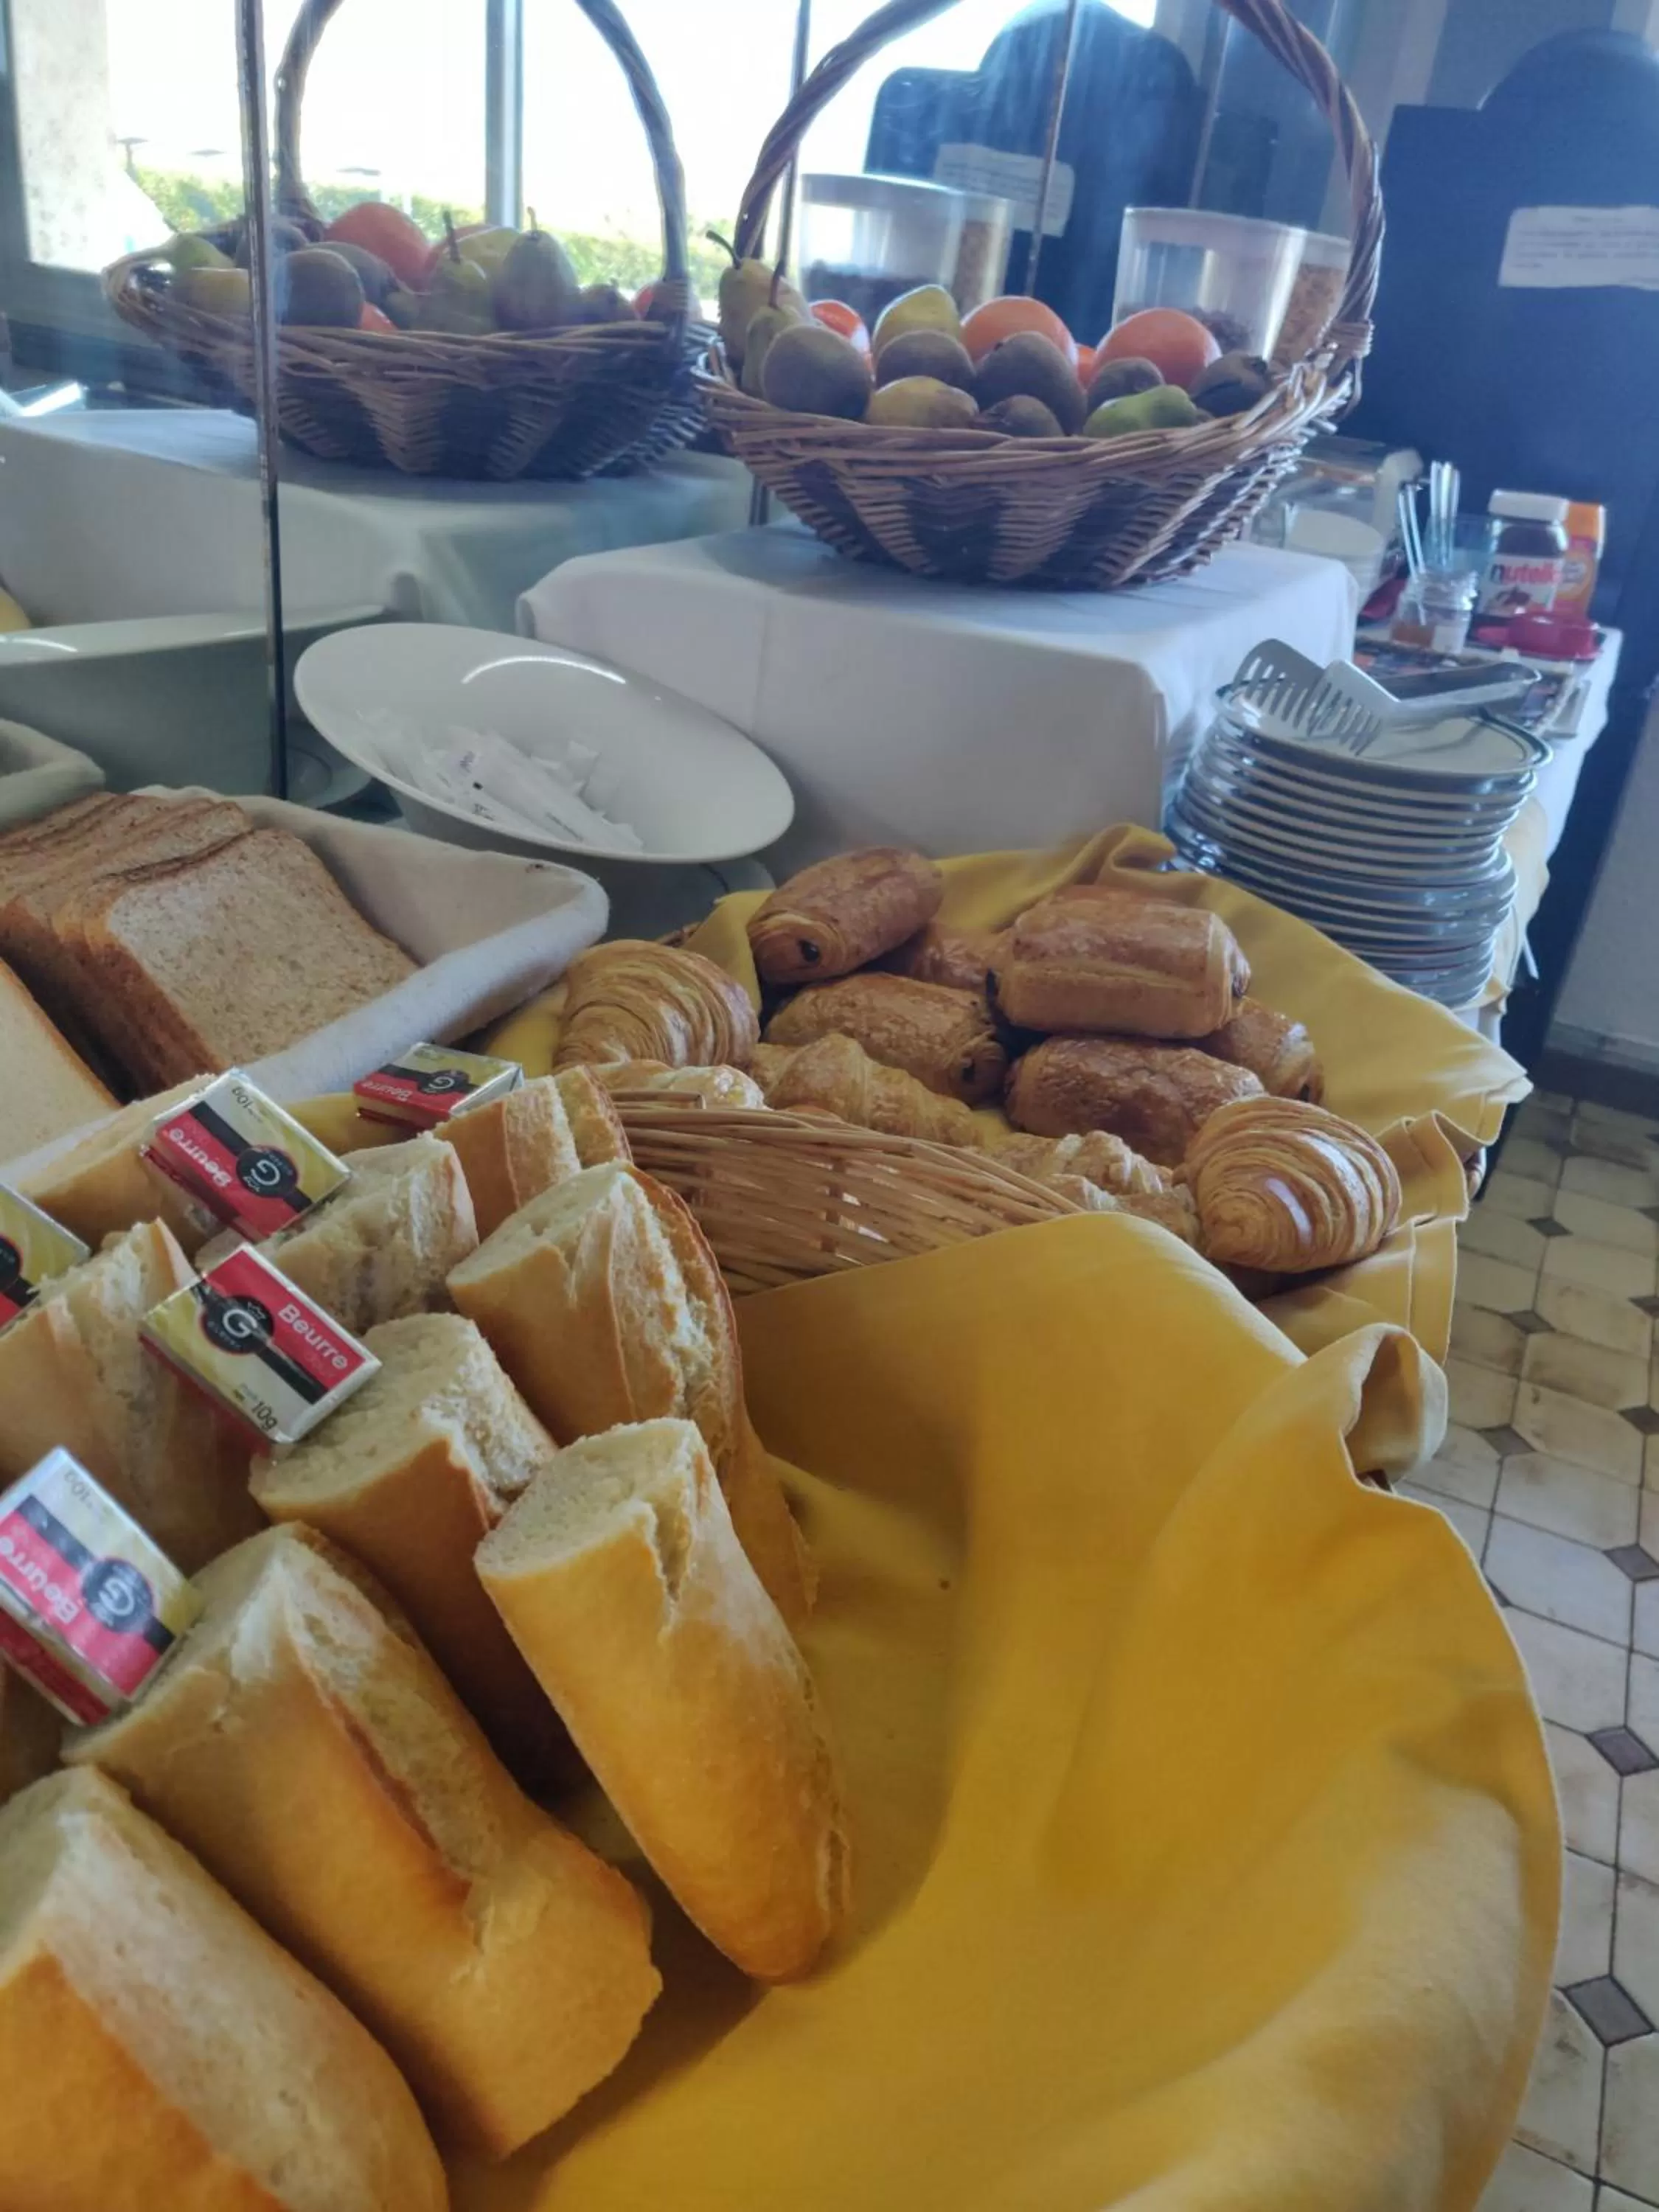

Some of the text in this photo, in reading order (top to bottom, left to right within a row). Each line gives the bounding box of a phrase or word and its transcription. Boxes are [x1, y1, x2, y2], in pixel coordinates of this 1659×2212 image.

[169, 1128, 232, 1187] Beurre
[223, 1308, 257, 1338] G
[277, 1303, 348, 1370] Beurre
[251, 1399, 278, 1432] 10g
